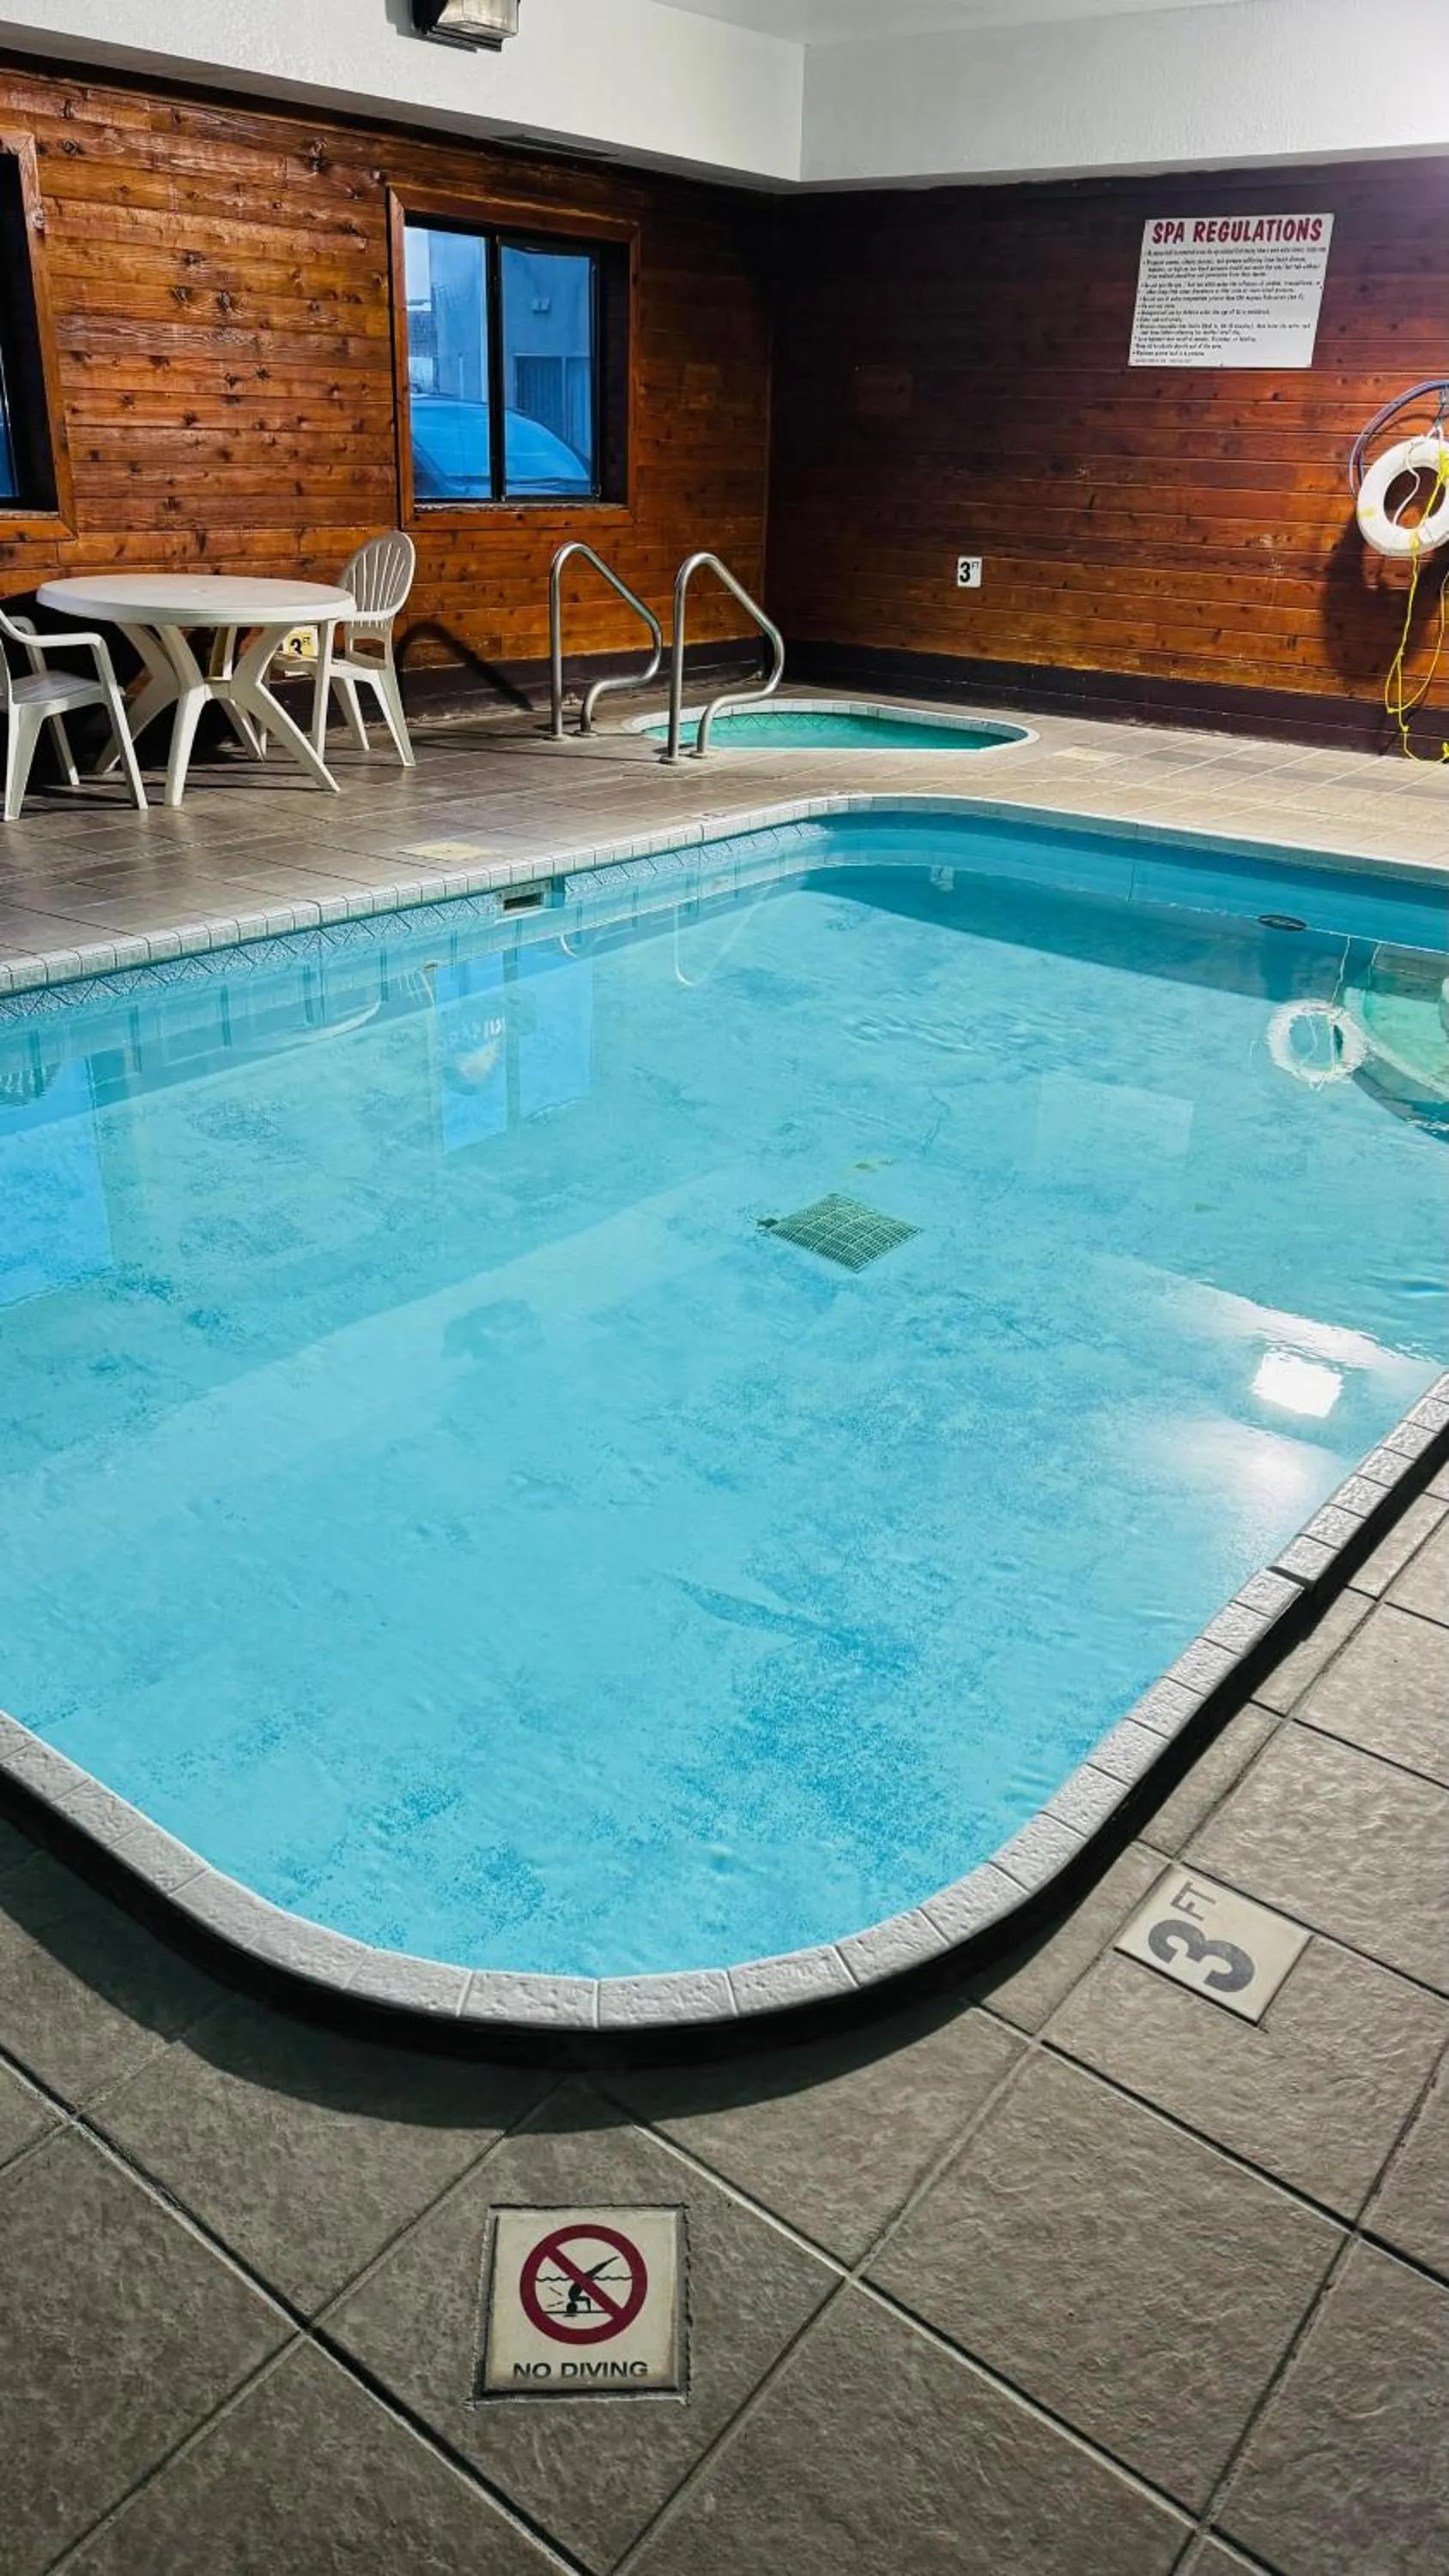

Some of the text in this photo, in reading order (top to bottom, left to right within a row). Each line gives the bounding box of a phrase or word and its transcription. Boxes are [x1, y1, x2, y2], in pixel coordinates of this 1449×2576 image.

[1152, 217, 1324, 244] SPA REGULATIONS
[959, 561, 971, 583] 3
[1147, 1880, 1256, 1993] 3 FT
[512, 2360, 649, 2379] NO DIVING
